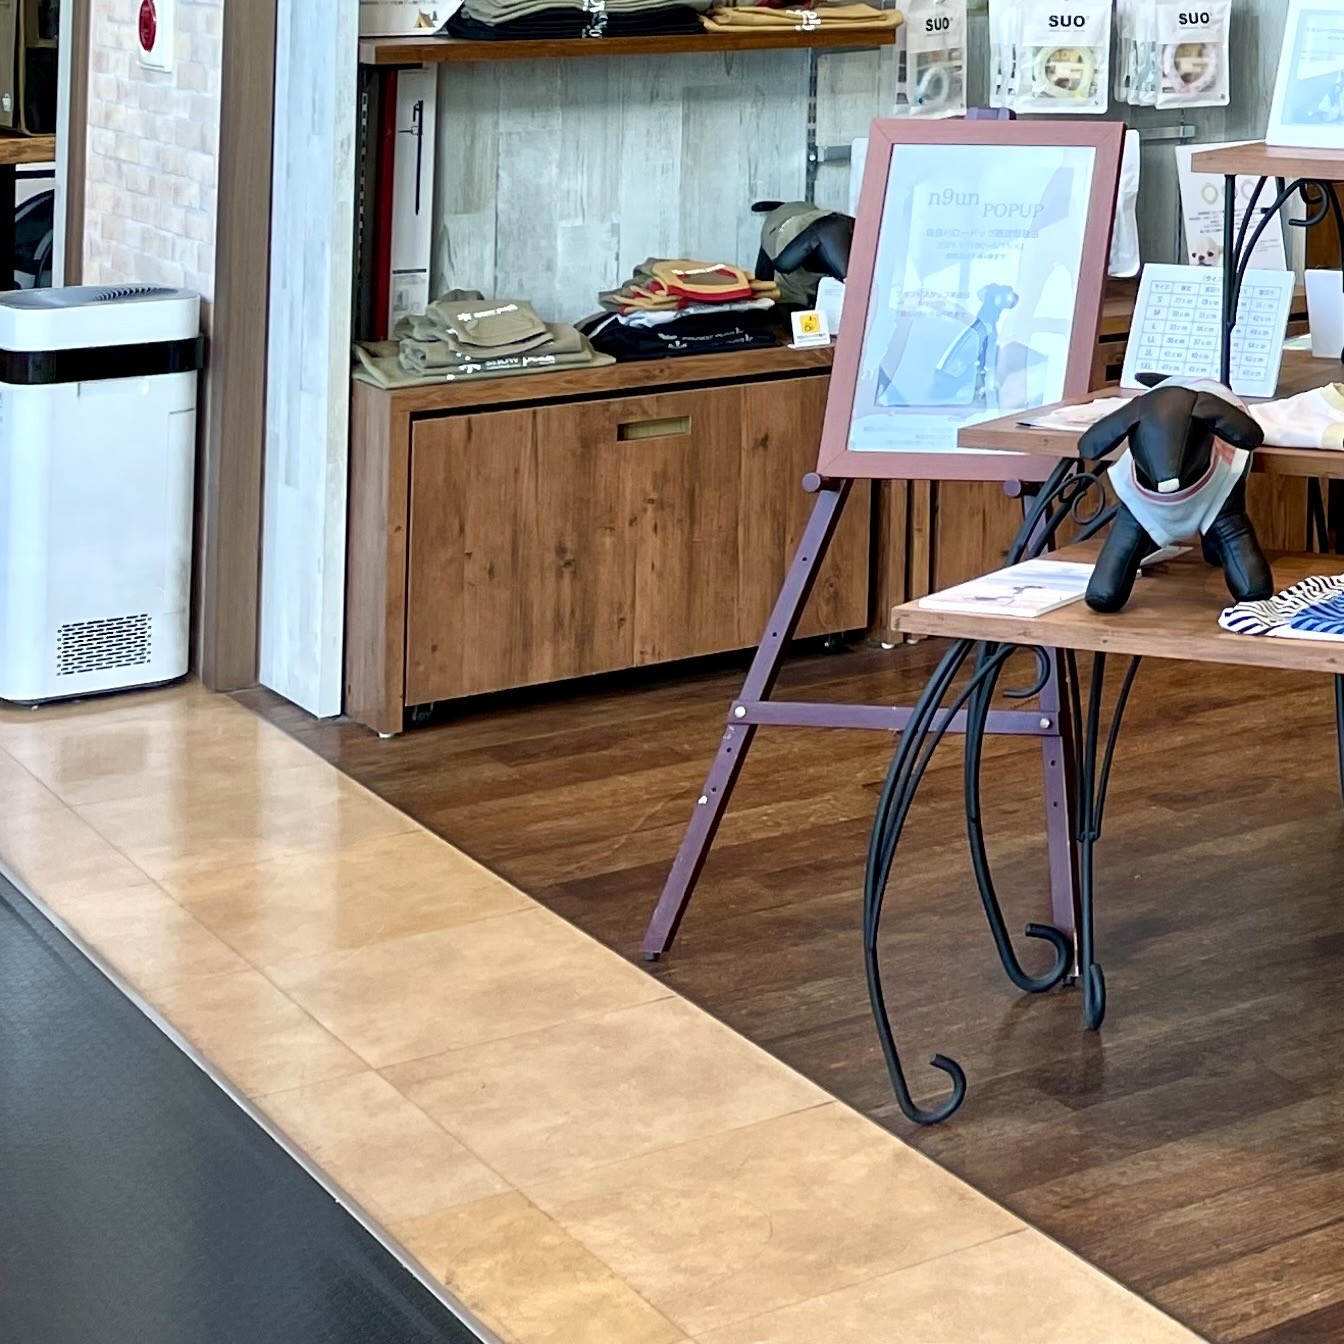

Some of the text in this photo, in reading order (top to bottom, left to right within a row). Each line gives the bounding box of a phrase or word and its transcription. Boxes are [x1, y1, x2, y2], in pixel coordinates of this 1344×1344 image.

[925, 17, 950, 32] SUO
[1048, 14, 1086, 28] SUO
[1178, 12, 1210, 26] SUO
[928, 188, 980, 207] n9un
[982, 203, 1044, 218] POPUP
